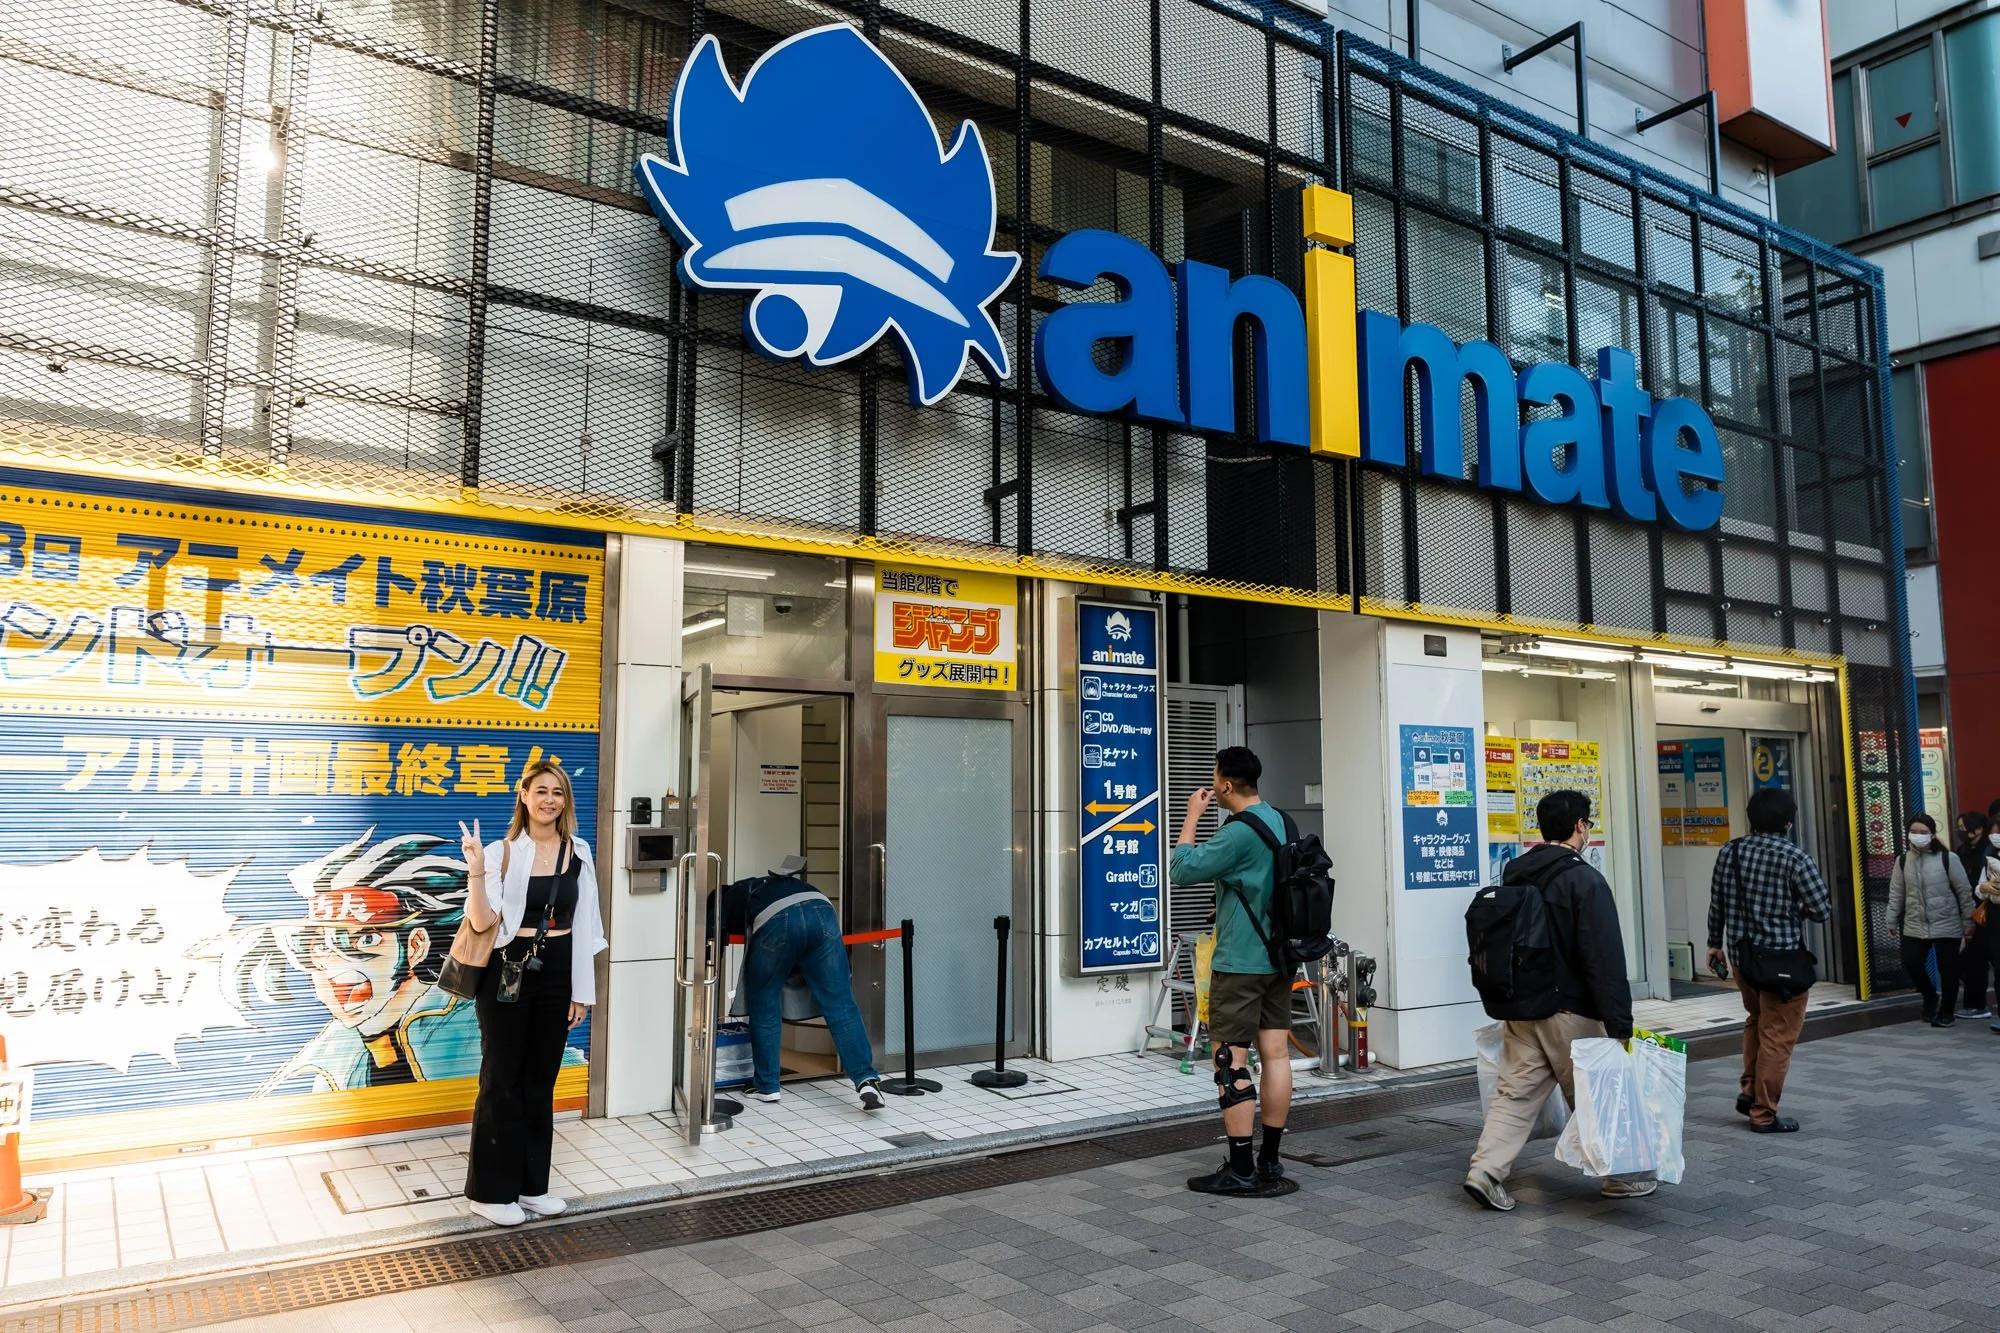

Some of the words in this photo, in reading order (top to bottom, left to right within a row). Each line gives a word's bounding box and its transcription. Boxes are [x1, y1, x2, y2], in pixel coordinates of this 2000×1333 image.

[1035, 184, 1726, 532] animate
[113, 532, 590, 624] アニメイト秋葉原
[881, 569, 959, 597] 当館2階で
[932, 606, 949, 618] 少年
[893, 601, 1000, 655] ジャンプ
[1092, 644, 1145, 665] animate
[899, 657, 1010, 685] グッズ展開中!
[1102, 681, 1156, 693] キャラクターグッズ
[1102, 712, 1114, 722] CD
[1102, 723, 1152, 736] DVD/Blu-ray
[1103, 747, 1138, 760] チケット
[1758, 751, 1770, 775] 2
[1103, 779, 1138, 800] 1号館
[1103, 834, 1139, 855] 2号館
[1412, 832, 1471, 845] キャラクターグッズ
[1420, 845, 1465, 858] 音楽・映像商品
[1434, 858, 1454, 869] などは
[1106, 870, 1139, 883] Gratte
[1110, 900, 1139, 912] マンガ
[1084, 934, 1139, 950] カプセルトイ
[1113, 949, 1131, 957] Capsule
